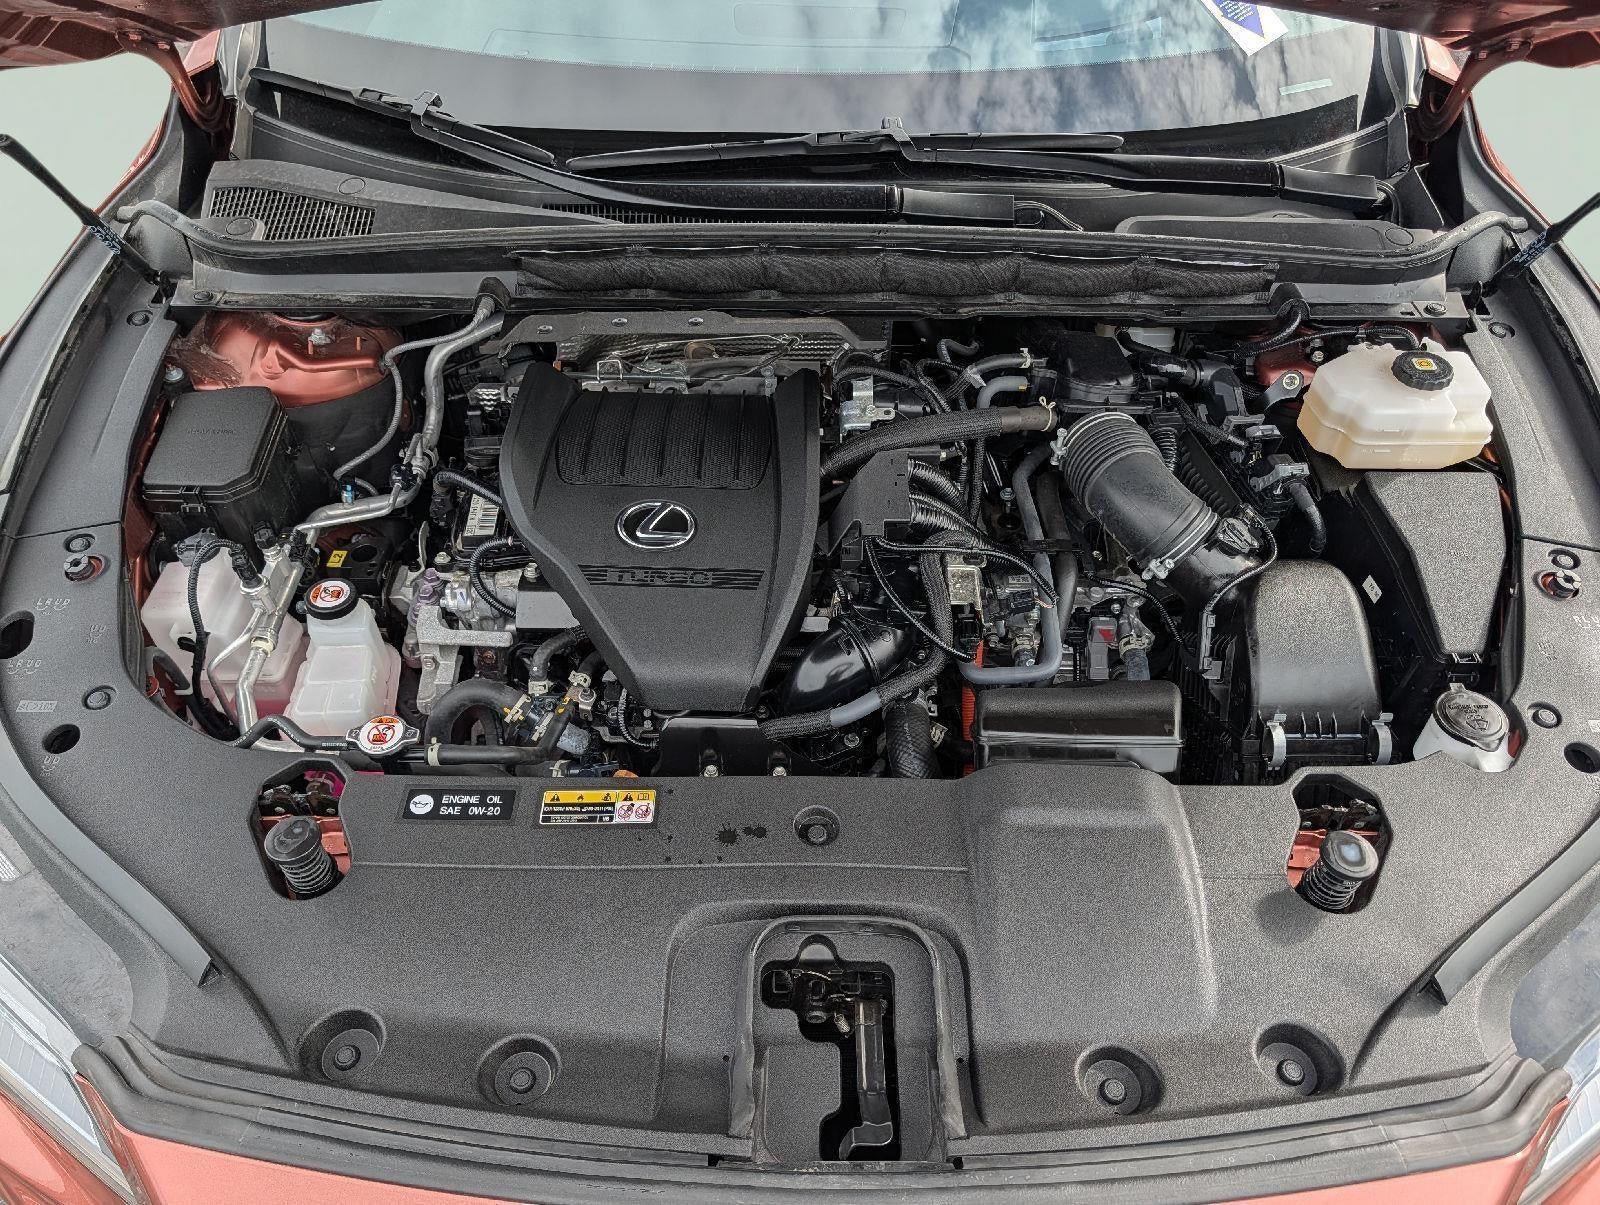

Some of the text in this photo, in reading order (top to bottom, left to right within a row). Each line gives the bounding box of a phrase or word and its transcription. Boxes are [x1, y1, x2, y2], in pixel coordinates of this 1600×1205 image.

[606, 569, 713, 585] TURBO
[441, 795, 503, 804] ENGINE OIL
[439, 806, 501, 815] SAE 0W-20
